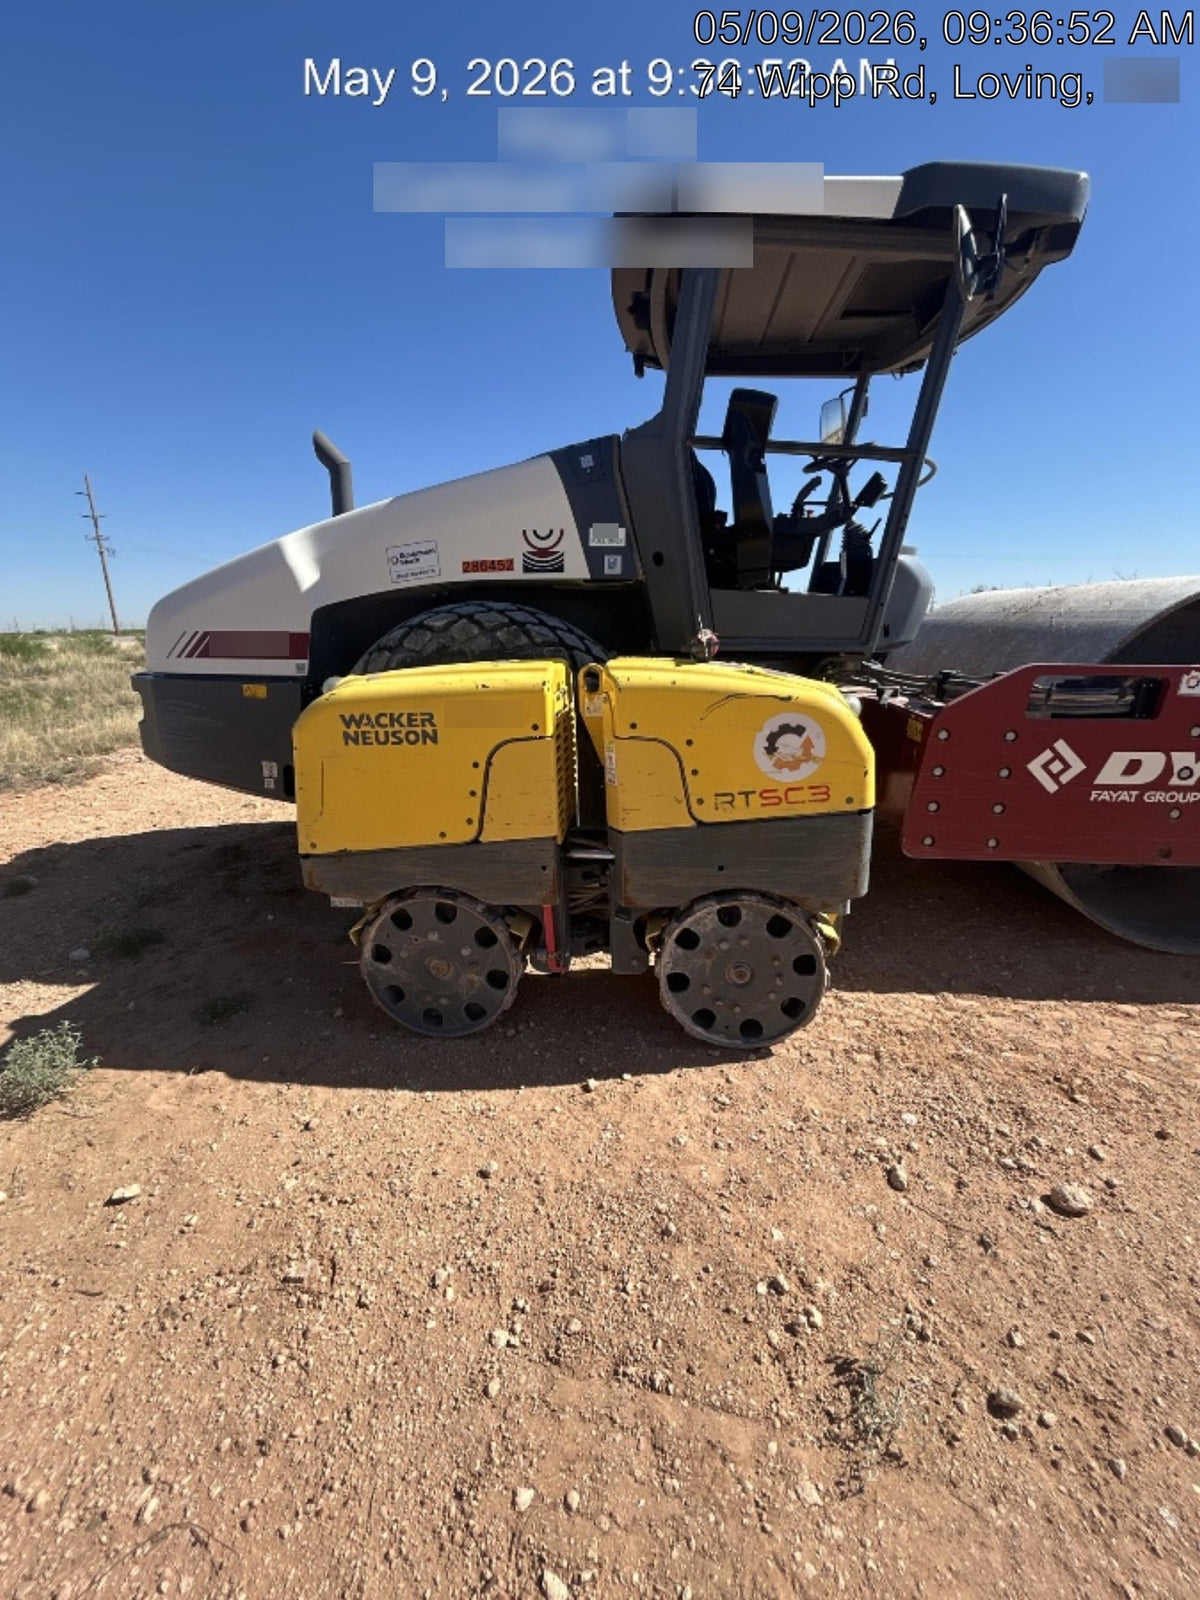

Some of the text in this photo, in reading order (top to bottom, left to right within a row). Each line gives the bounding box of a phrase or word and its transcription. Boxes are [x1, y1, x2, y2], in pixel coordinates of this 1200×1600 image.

[462, 558, 514, 573] 286452
[338, 712, 437, 729] WACKER
[342, 729, 438, 746] NEUSON
[714, 785, 831, 812] RTSC3
[1089, 790, 1140, 803] FAYAT
[1143, 790, 1200, 803] GROUP
